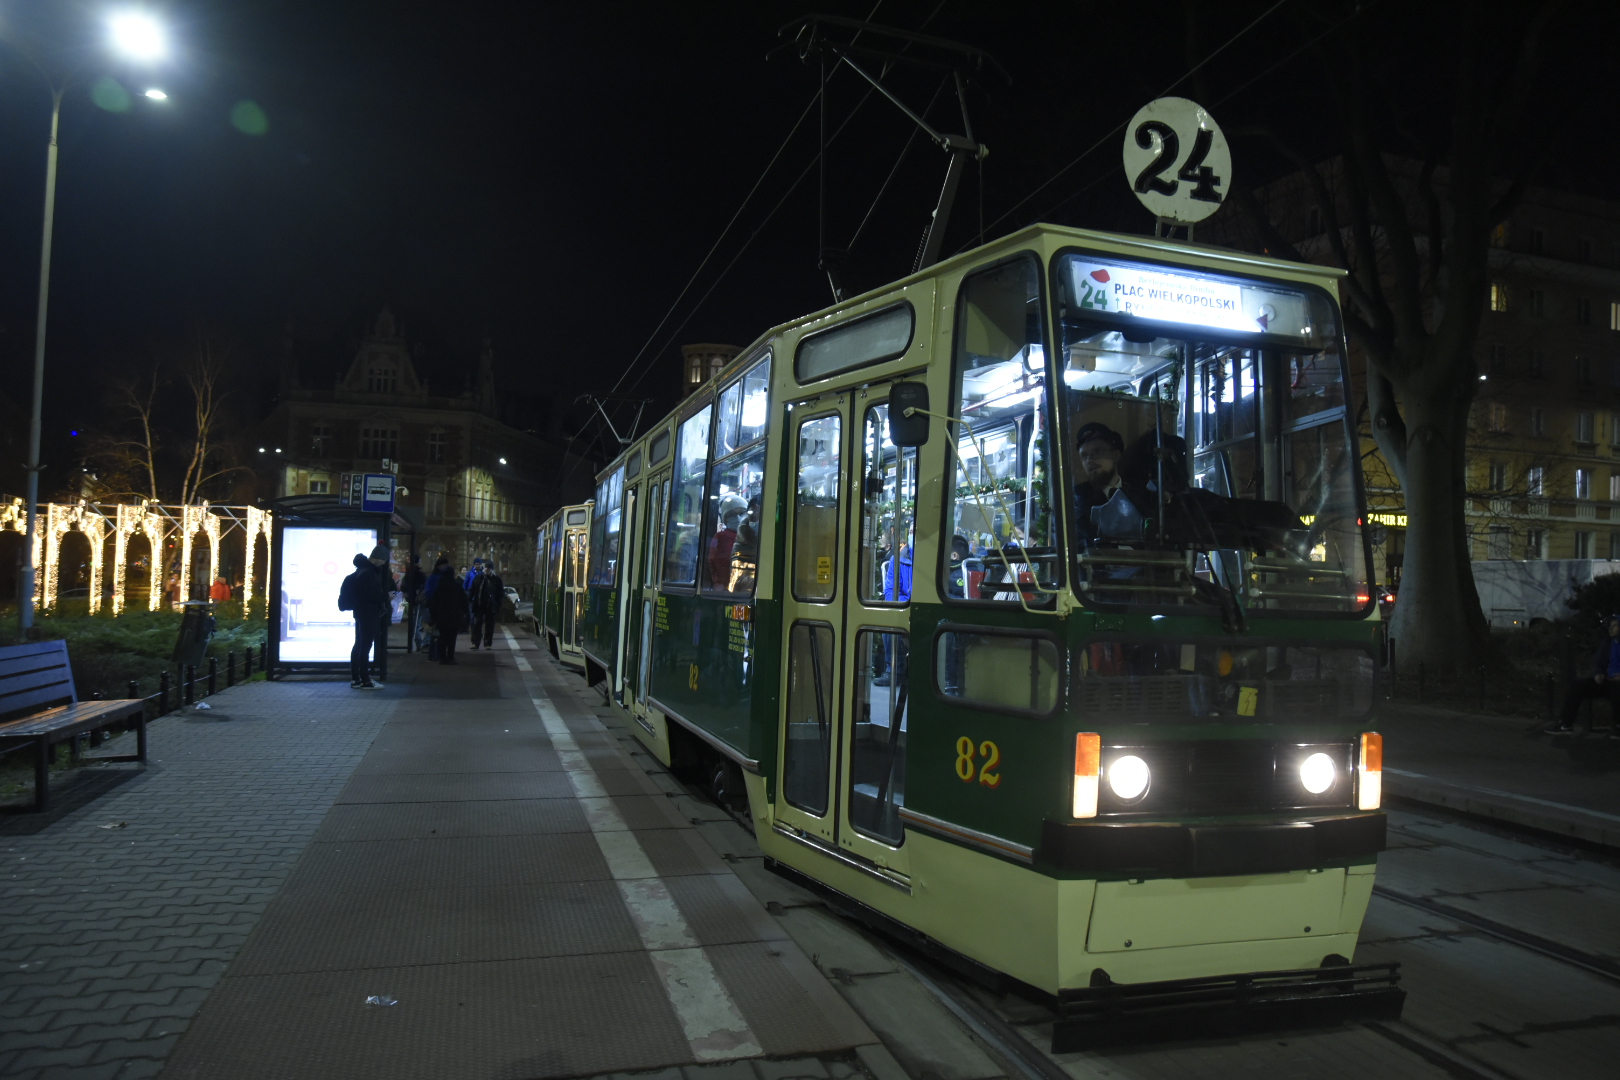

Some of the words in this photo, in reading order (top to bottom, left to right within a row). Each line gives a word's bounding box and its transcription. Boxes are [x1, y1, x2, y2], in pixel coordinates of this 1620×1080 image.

[1135, 120, 1222, 204] 24
[1080, 279, 1108, 310] 24
[1114, 283, 1145, 299] PLAC
[1148, 288, 1235, 311] WIELKOPOLSKI
[689, 663, 699, 691] 82
[955, 735, 1003, 789] 82
